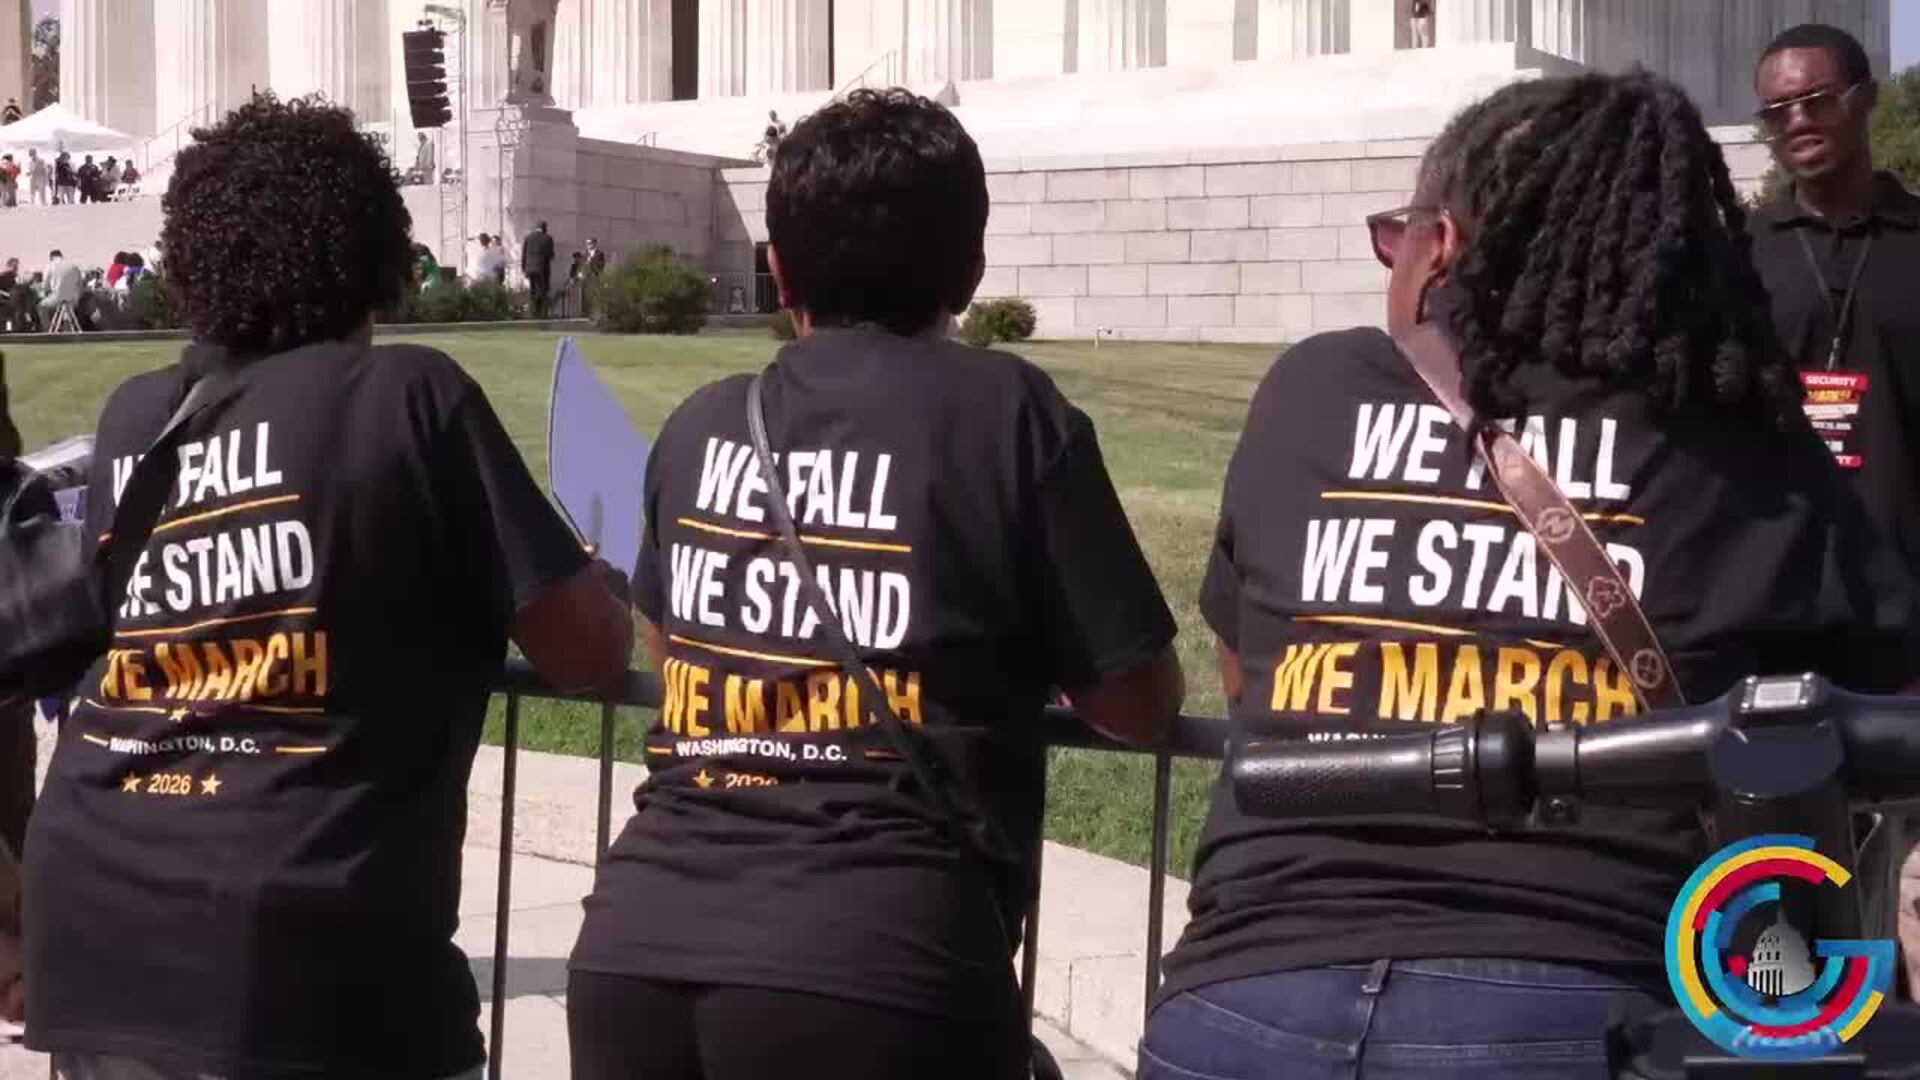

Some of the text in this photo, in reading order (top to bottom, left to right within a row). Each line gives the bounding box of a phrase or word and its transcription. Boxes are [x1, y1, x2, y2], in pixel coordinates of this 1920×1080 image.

[175, 421, 283, 508] FALL
[1348, 403, 1452, 483] WE
[696, 437, 897, 531] WE FALL
[162, 519, 314, 613] STAND
[671, 543, 729, 627] WE
[1301, 518, 1396, 603] WE
[154, 632, 327, 700] MARCH
[662, 656, 711, 737] WE
[1271, 642, 1638, 724] WE MARCH
[147, 772, 193, 795] 2026
[220, 737, 261, 754] D.C.
[676, 737, 848, 761] WASHINGTON, D.C.
